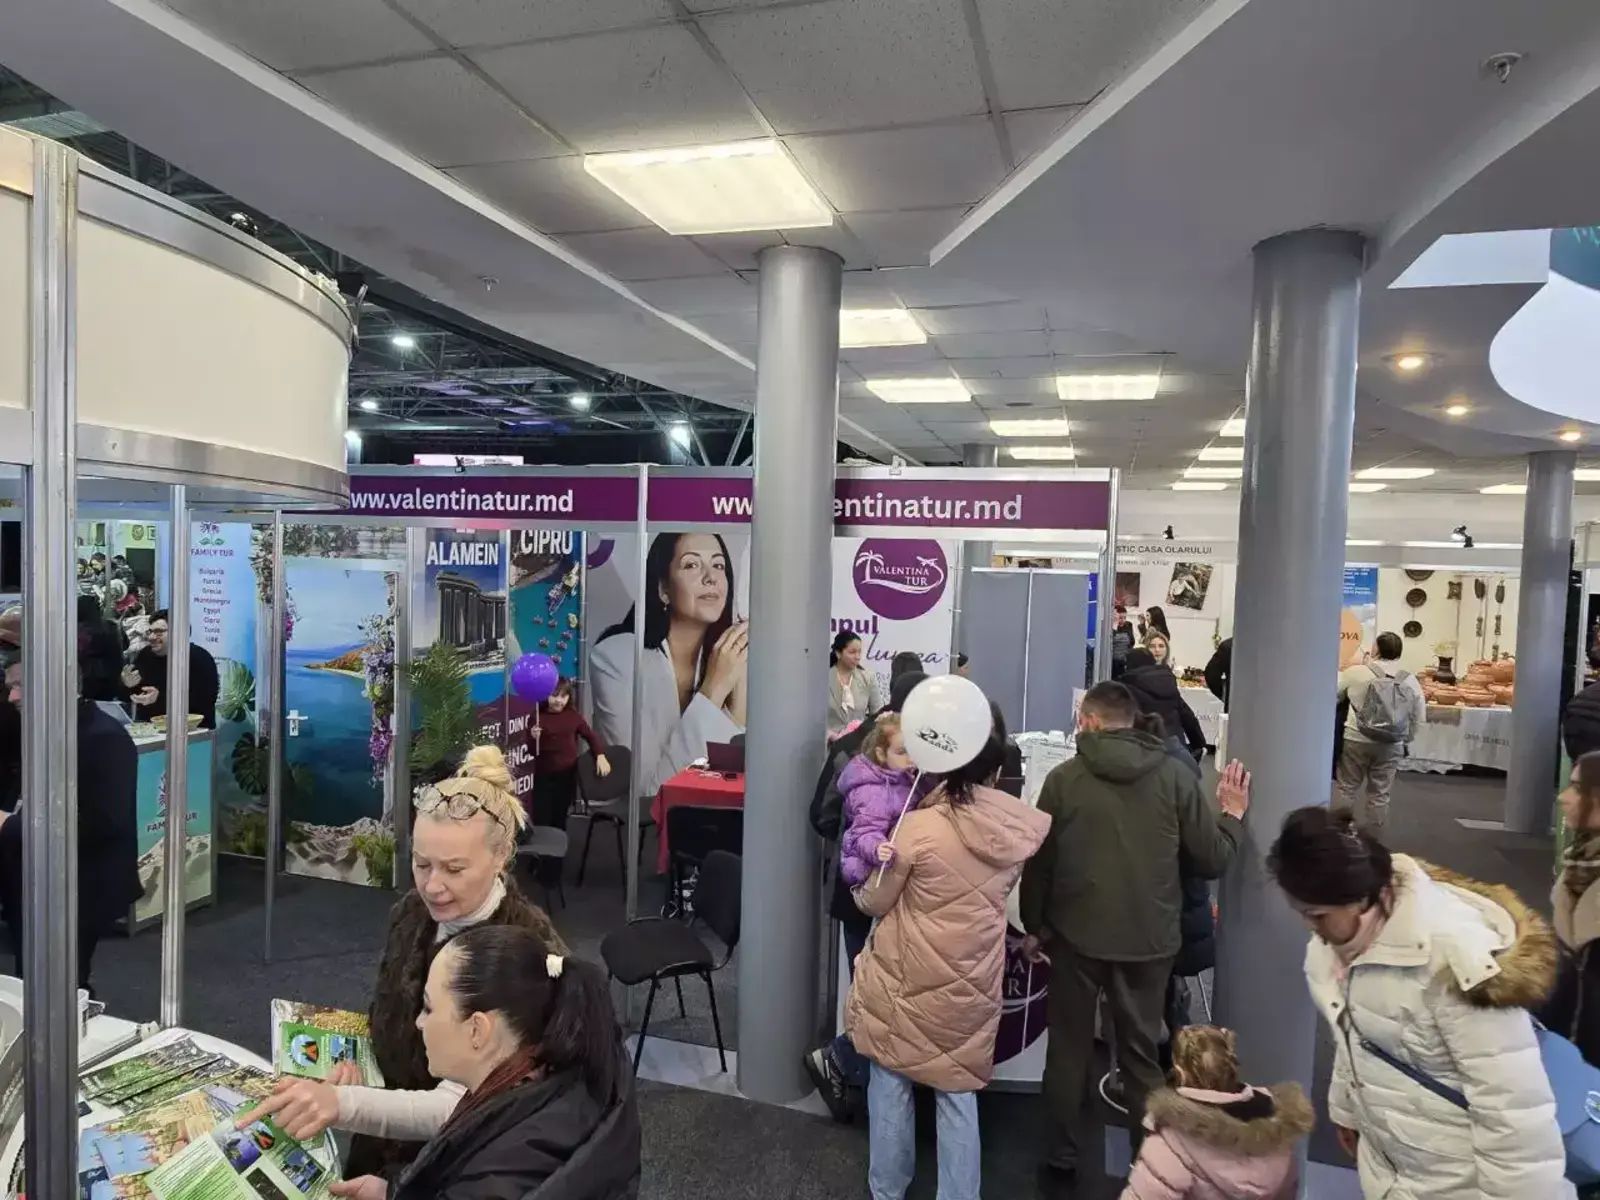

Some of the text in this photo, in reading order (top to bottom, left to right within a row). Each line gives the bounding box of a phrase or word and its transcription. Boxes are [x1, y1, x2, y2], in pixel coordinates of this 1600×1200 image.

[520, 530, 573, 555] CIPRU
[190, 548, 217, 557] FAMILY
[426, 541, 499, 566] ALAMEIN
[1138, 545, 1163, 553] CASA
[1165, 545, 1213, 554] OLARULUI
[873, 565, 930, 576] VALENTINA
[905, 576, 928, 586] TUR
[831, 615, 879, 635] pul
